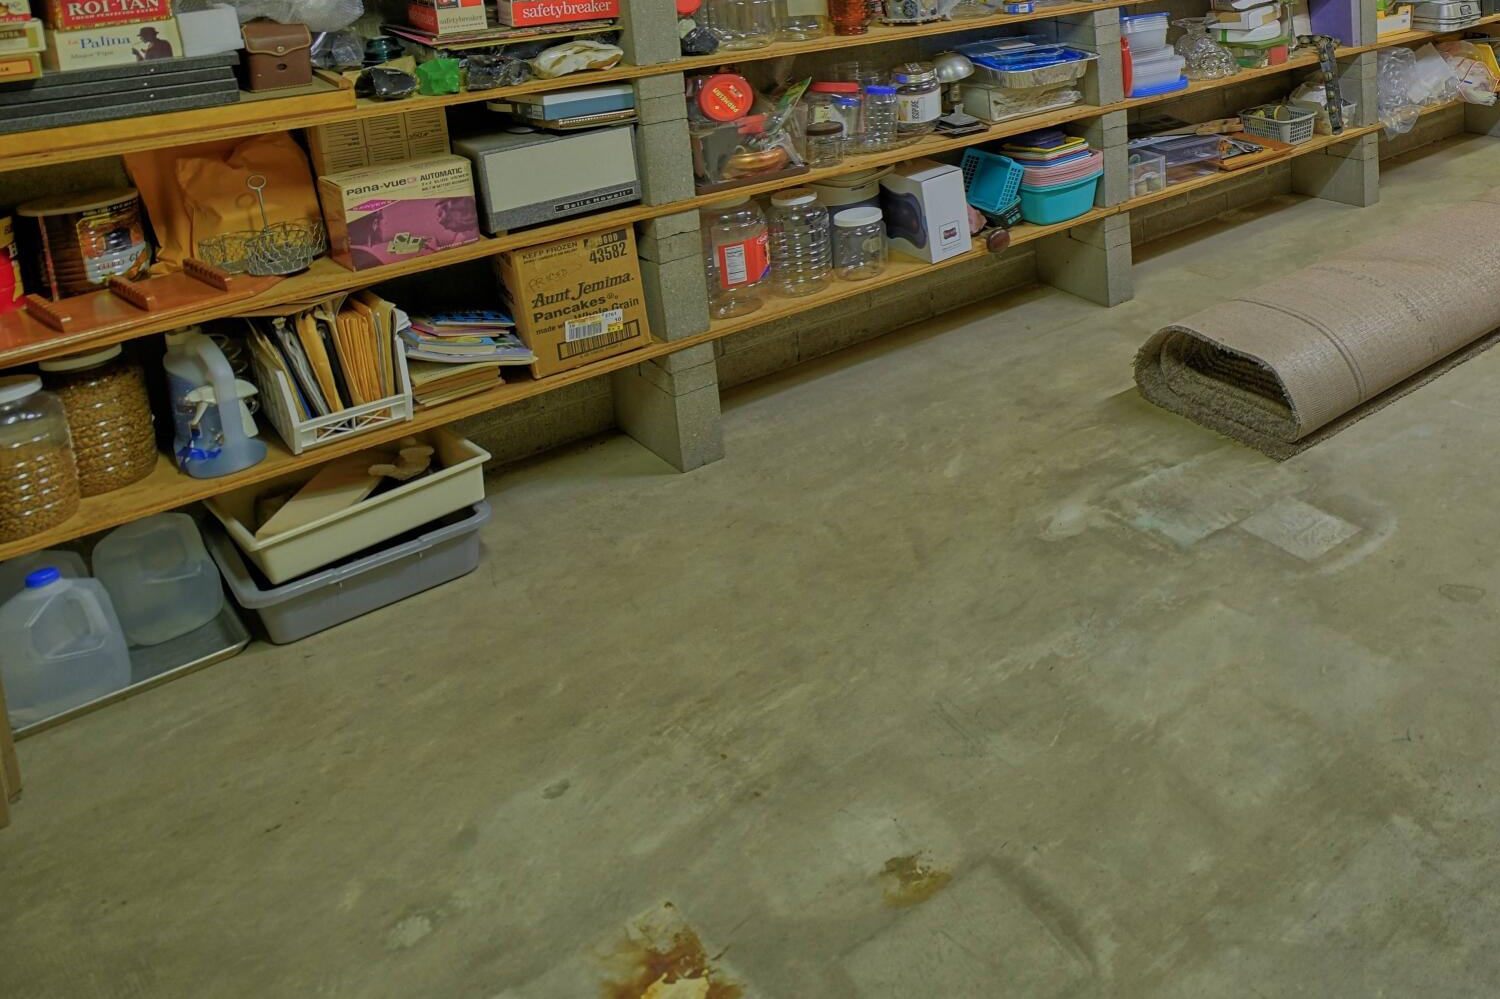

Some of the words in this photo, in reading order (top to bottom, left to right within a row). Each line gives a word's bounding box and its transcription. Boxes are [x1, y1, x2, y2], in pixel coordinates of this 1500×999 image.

[522, 1, 612, 19] safetybreaker
[80, 34, 132, 50] Palina
[419, 166, 464, 182] AUTOMATIC
[563, 200, 584, 210] Bell
[592, 190, 626, 203] Howell
[545, 241, 578, 256] FROZEN
[588, 241, 628, 265] 43582
[531, 287, 571, 310] Aunt
[535, 324, 556, 336] made
[611, 297, 640, 313] Grain
